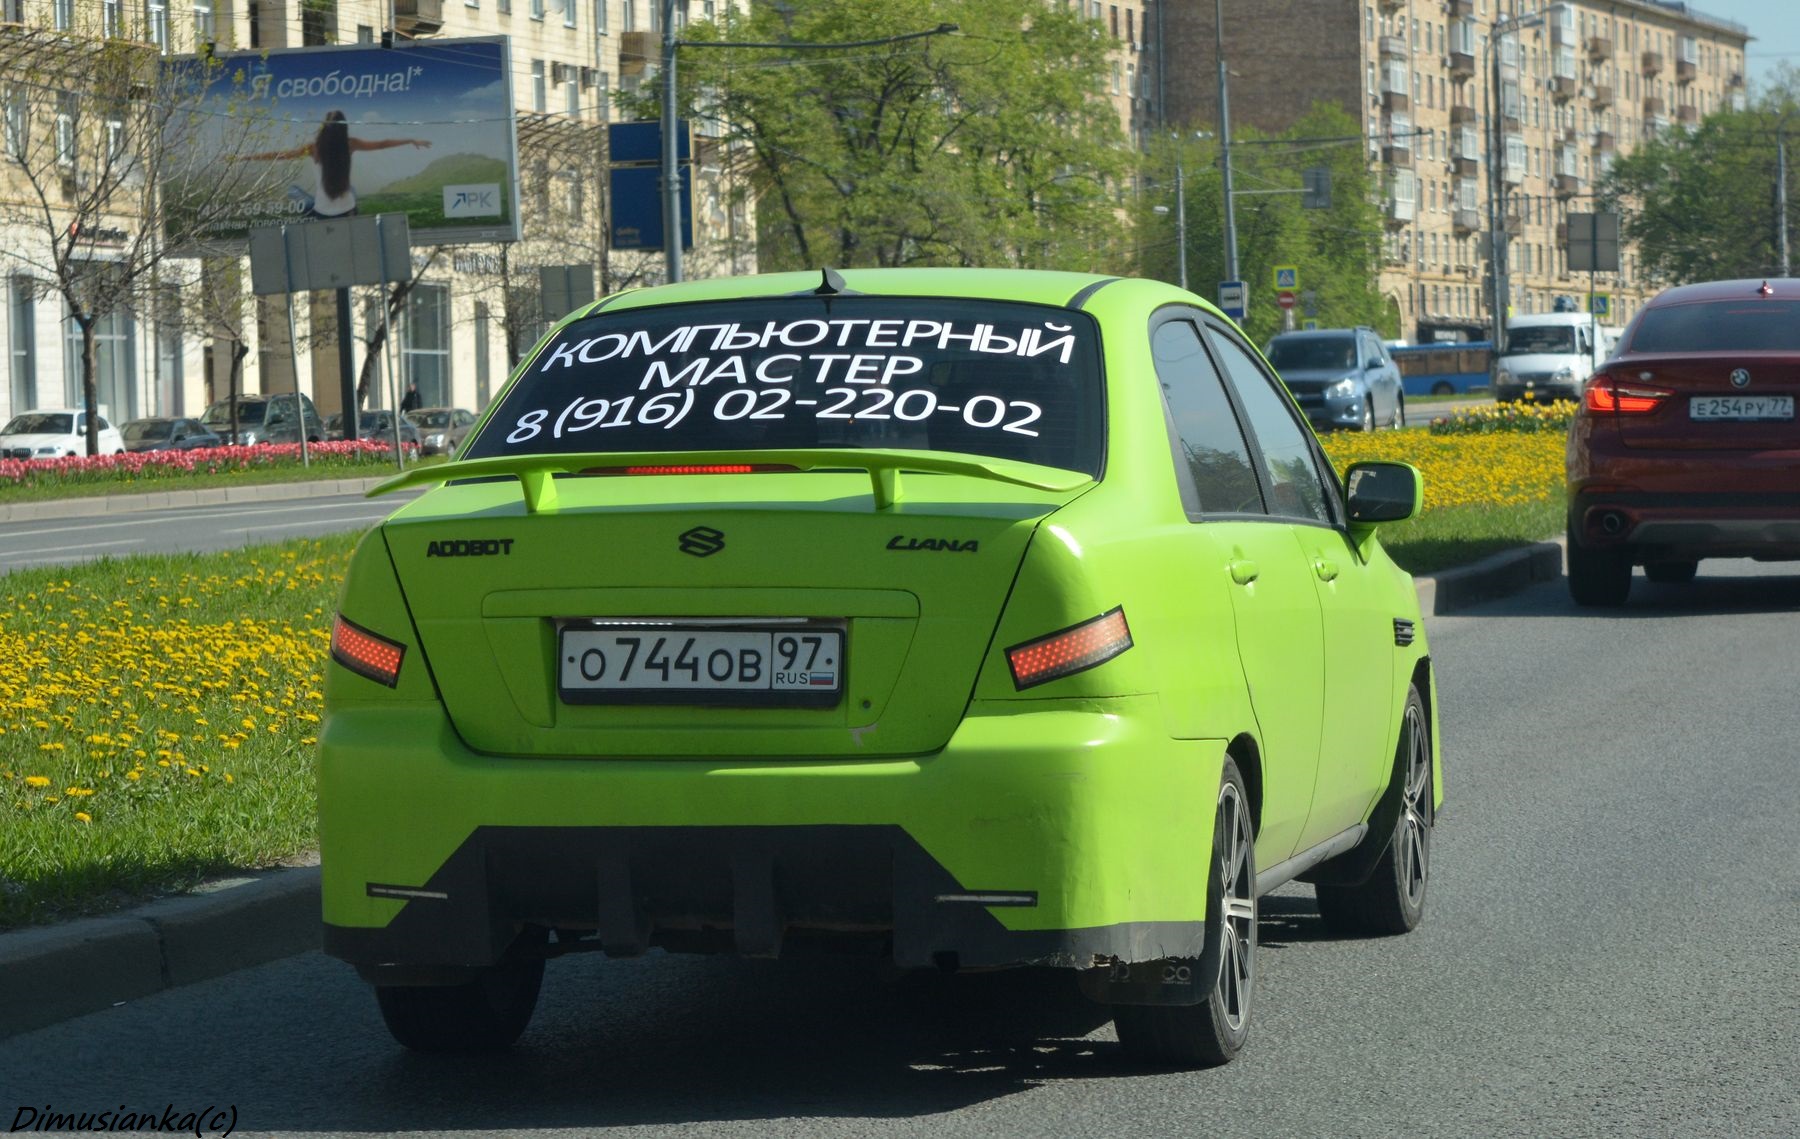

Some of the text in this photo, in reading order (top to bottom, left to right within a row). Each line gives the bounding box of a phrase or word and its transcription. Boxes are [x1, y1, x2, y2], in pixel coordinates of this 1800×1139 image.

[249, 74, 273, 101] Я
[541, 319, 1075, 373] КОМПЬЮТЕРНЫЙ
[639, 354, 923, 390] МАСТЕР
[506, 388, 1042, 444] 8 (916) 02-220-02
[1771, 398, 1787, 411] 77
[886, 535, 978, 552] LIANA
[777, 637, 822, 670] 97
[776, 672, 808, 684] RUS
